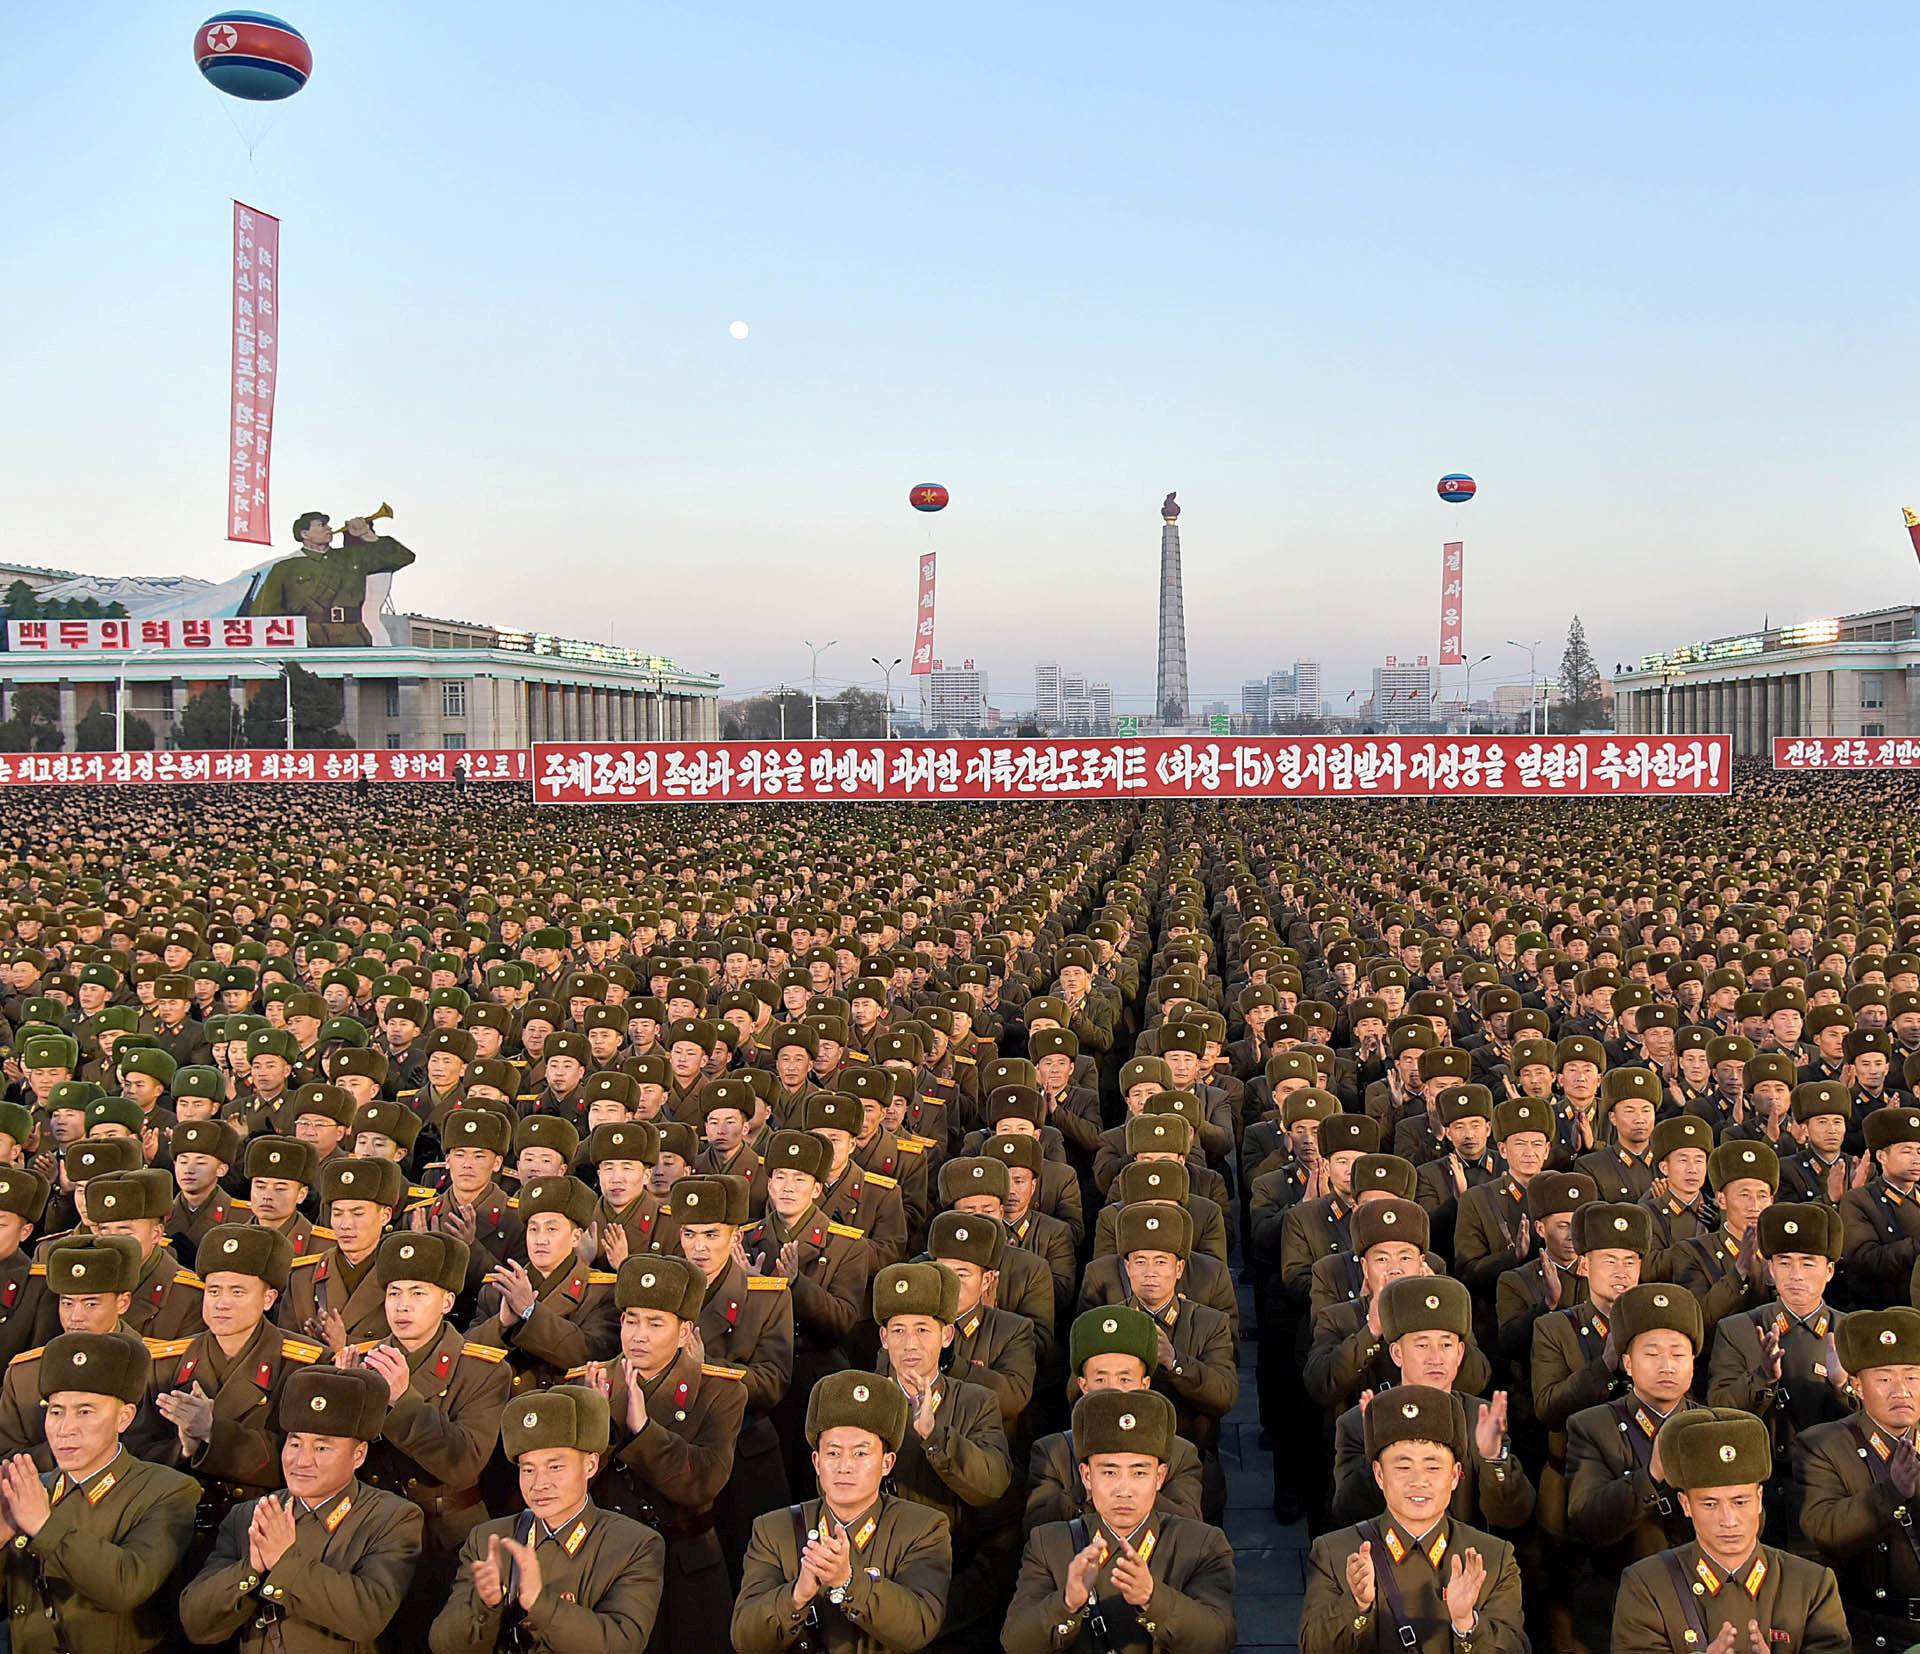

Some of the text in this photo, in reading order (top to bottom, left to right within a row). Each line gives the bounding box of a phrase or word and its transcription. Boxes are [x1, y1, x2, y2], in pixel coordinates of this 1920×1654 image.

[17, 755, 106, 782] 최고령도자
[215, 754, 253, 779] 따라
[261, 753, 315, 780] 최후의
[323, 752, 380, 779] 승리를
[390, 752, 446, 778] 향하여
[540, 750, 658, 797] 주체조선의
[662, 750, 735, 796] 존엄과
[738, 748, 806, 795] 위용을
[810, 748, 885, 794] 만방에
[890, 747, 962, 793] 과시한
[965, 746, 1148, 792] 대륙간탄도로케트
[1409, 742, 1507, 790] 대성공을
[1515, 742, 1588, 789] 열렬히
[1592, 741, 1722, 789] 축하한다!
